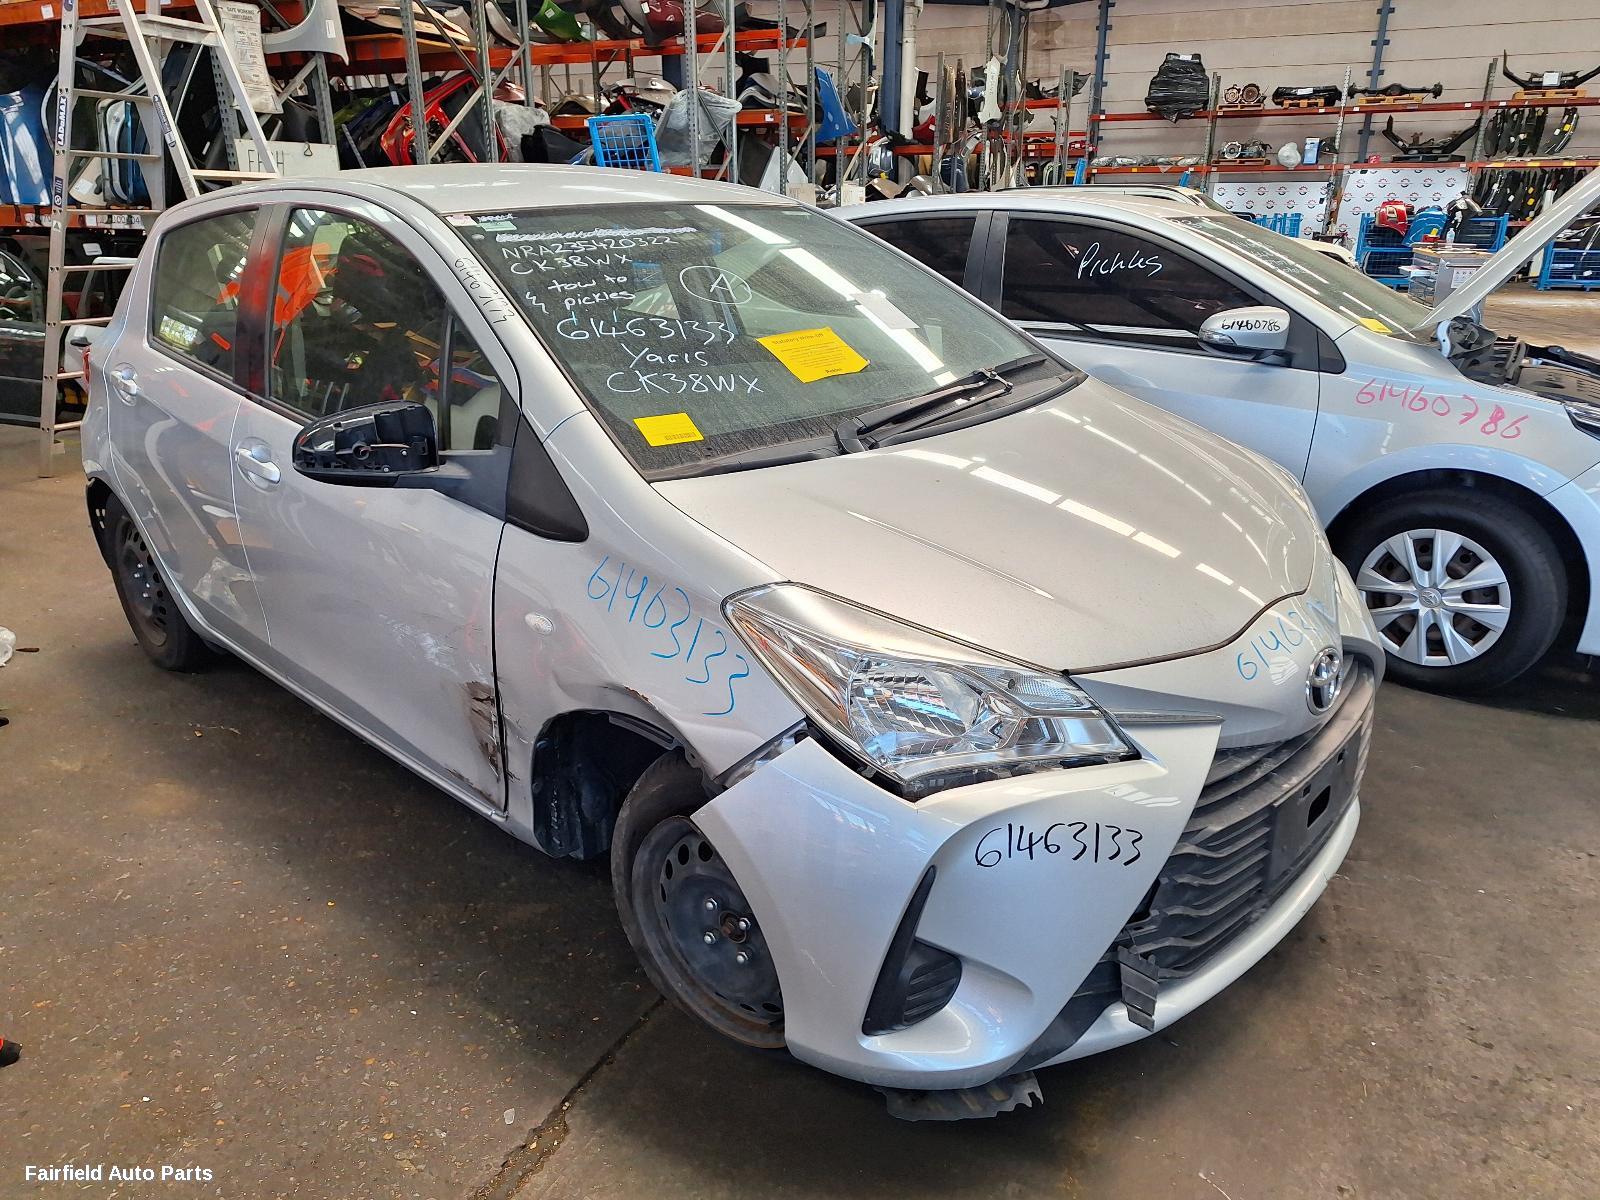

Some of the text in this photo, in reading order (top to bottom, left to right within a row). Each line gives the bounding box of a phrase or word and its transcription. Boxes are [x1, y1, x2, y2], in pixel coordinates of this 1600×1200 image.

[548, 273, 628, 293] tow to
[564, 290, 636, 311] pickles
[557, 314, 735, 346] 61463133
[1221, 318, 1281, 332] 61460786
[620, 343, 708, 368] Yaris
[606, 370, 764, 394] CK38WX
[1355, 378, 1530, 439] 61460786
[587, 556, 750, 716] 61463133
[975, 821, 1143, 868] 61463133
